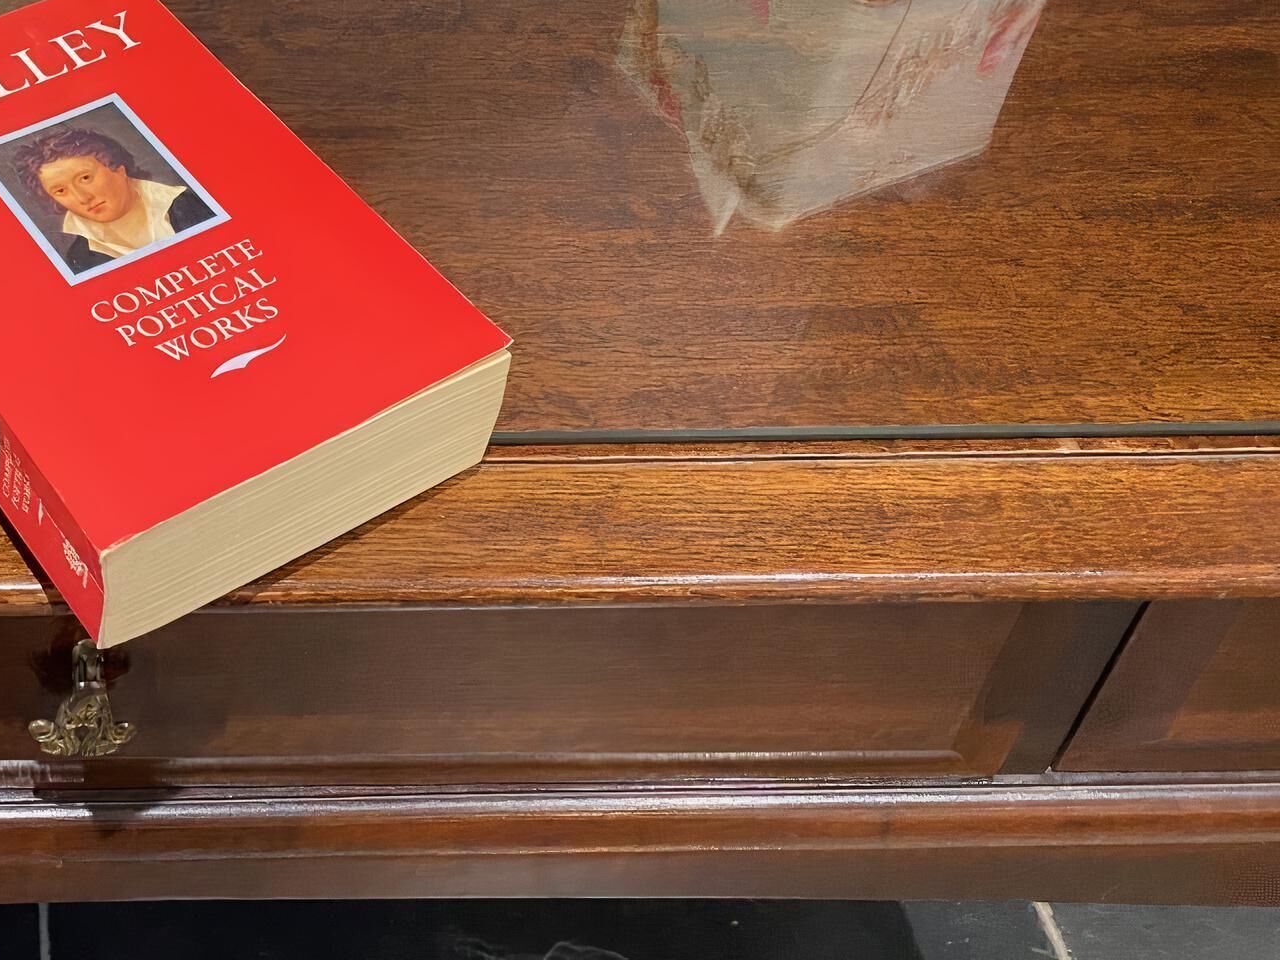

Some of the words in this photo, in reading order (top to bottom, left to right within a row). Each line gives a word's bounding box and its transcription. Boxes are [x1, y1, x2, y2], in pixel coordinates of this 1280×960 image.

[91, 237, 264, 325] COMPLETE
[116, 272, 277, 347] POETICAL
[154, 297, 280, 363] WORKS
